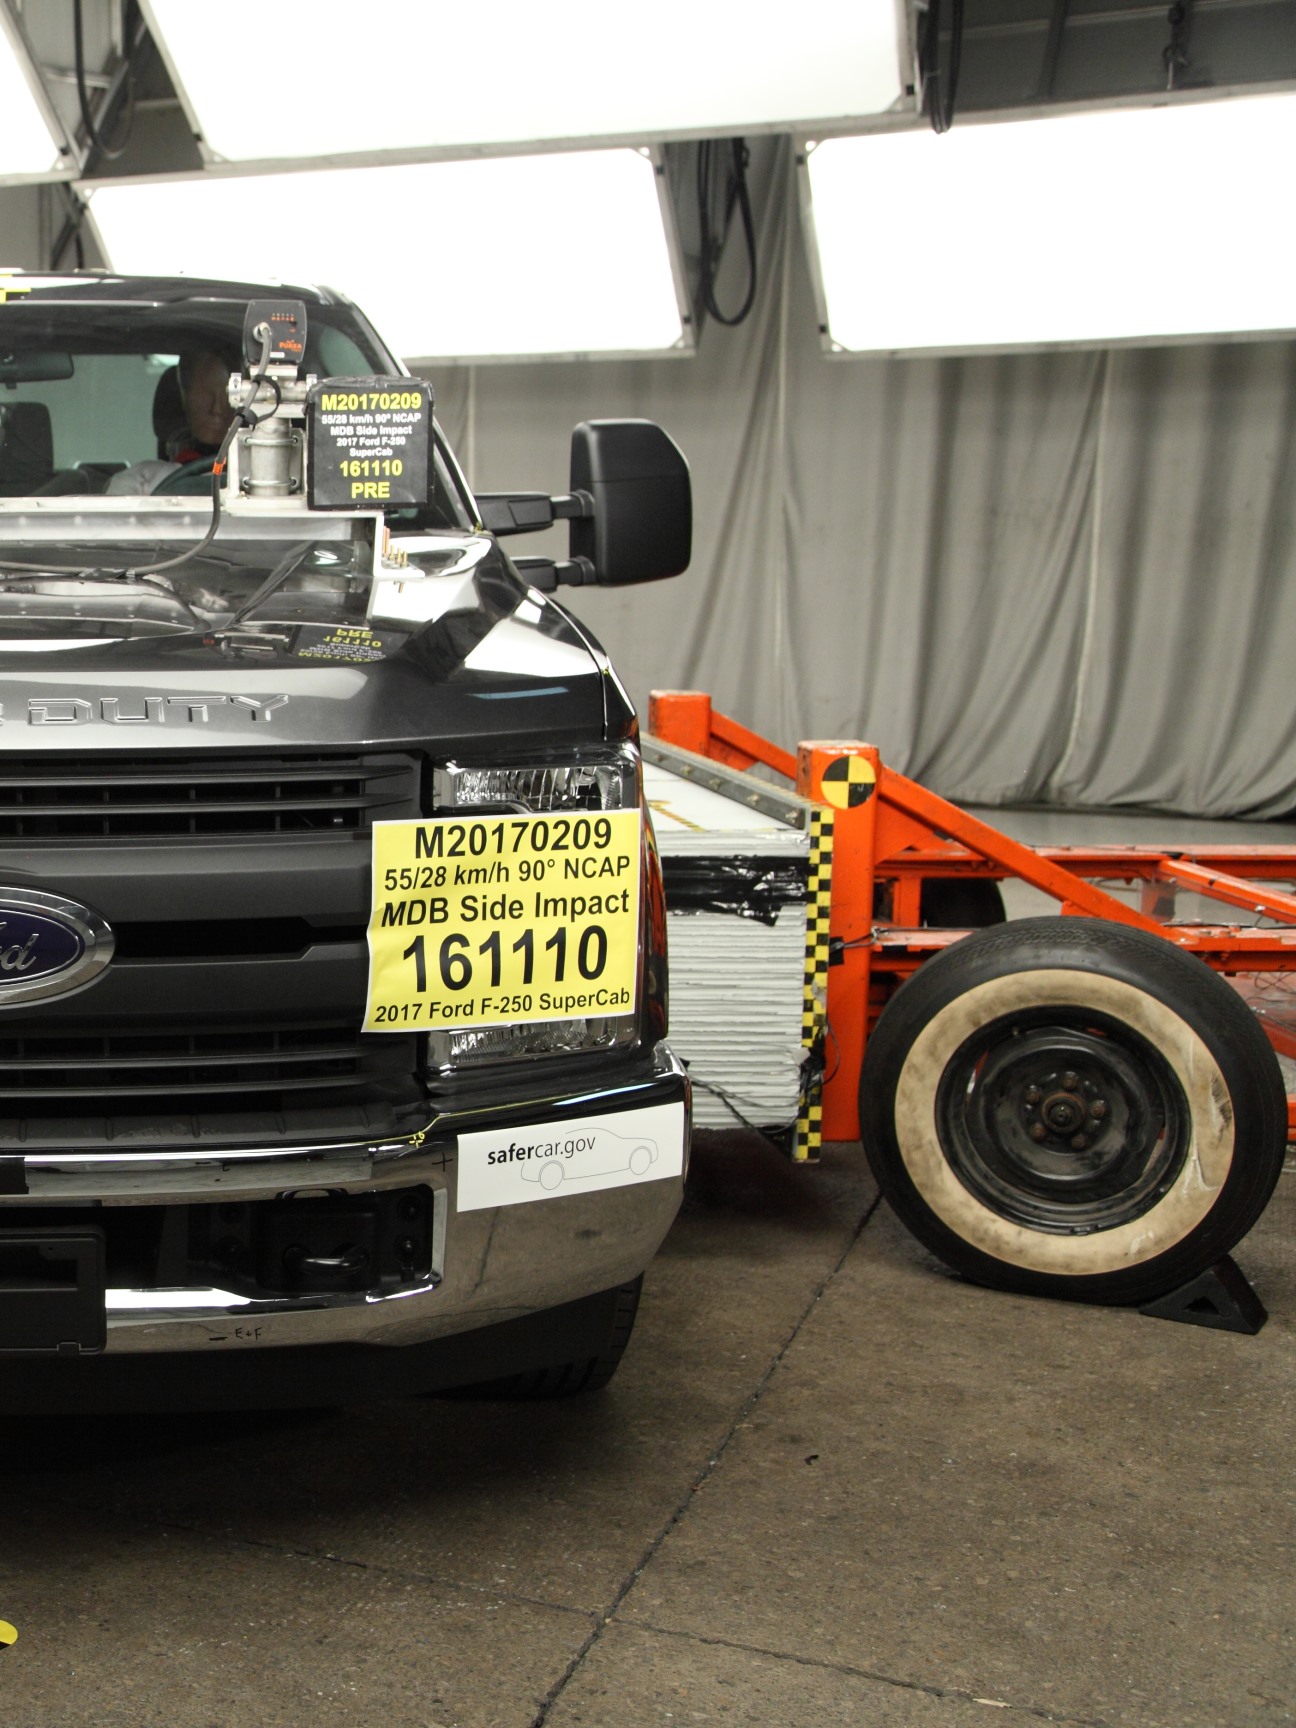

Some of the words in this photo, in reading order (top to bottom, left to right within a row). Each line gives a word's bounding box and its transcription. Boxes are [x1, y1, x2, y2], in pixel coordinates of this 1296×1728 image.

[321, 392, 422, 411] M20170209
[321, 414, 348, 425] 55/28
[349, 413, 374, 424] km/h
[392, 412, 422, 423] NCAP
[330, 426, 354, 436] MDB
[355, 425, 378, 436] Side
[379, 425, 413, 437] Impact
[336, 437, 358, 447] 2017
[359, 436, 380, 446] Ford
[381, 436, 406, 446] F-250
[349, 447, 394, 458] SuperCab
[339, 459, 403, 477] 161110
[351, 481, 391, 499] PRE
[26, 694, 289, 727] DUTY
[415, 818, 612, 859] M20170209
[384, 865, 447, 891] 55/28
[454, 861, 510, 886] km/h
[564, 855, 630, 880] NCAP
[380, 897, 449, 927] MDB
[460, 893, 524, 922] Side
[534, 888, 630, 922] Impact
[403, 924, 608, 993] 161110
[374, 1003, 423, 1023] 2017
[429, 999, 474, 1020] Ford
[480, 994, 533, 1015] F-250
[539, 988, 630, 1013] SuperCab
[487, 1136, 596, 1165] safercar.gov
[235, 1327, 244, 1339] E
[254, 1326, 263, 1340] F
